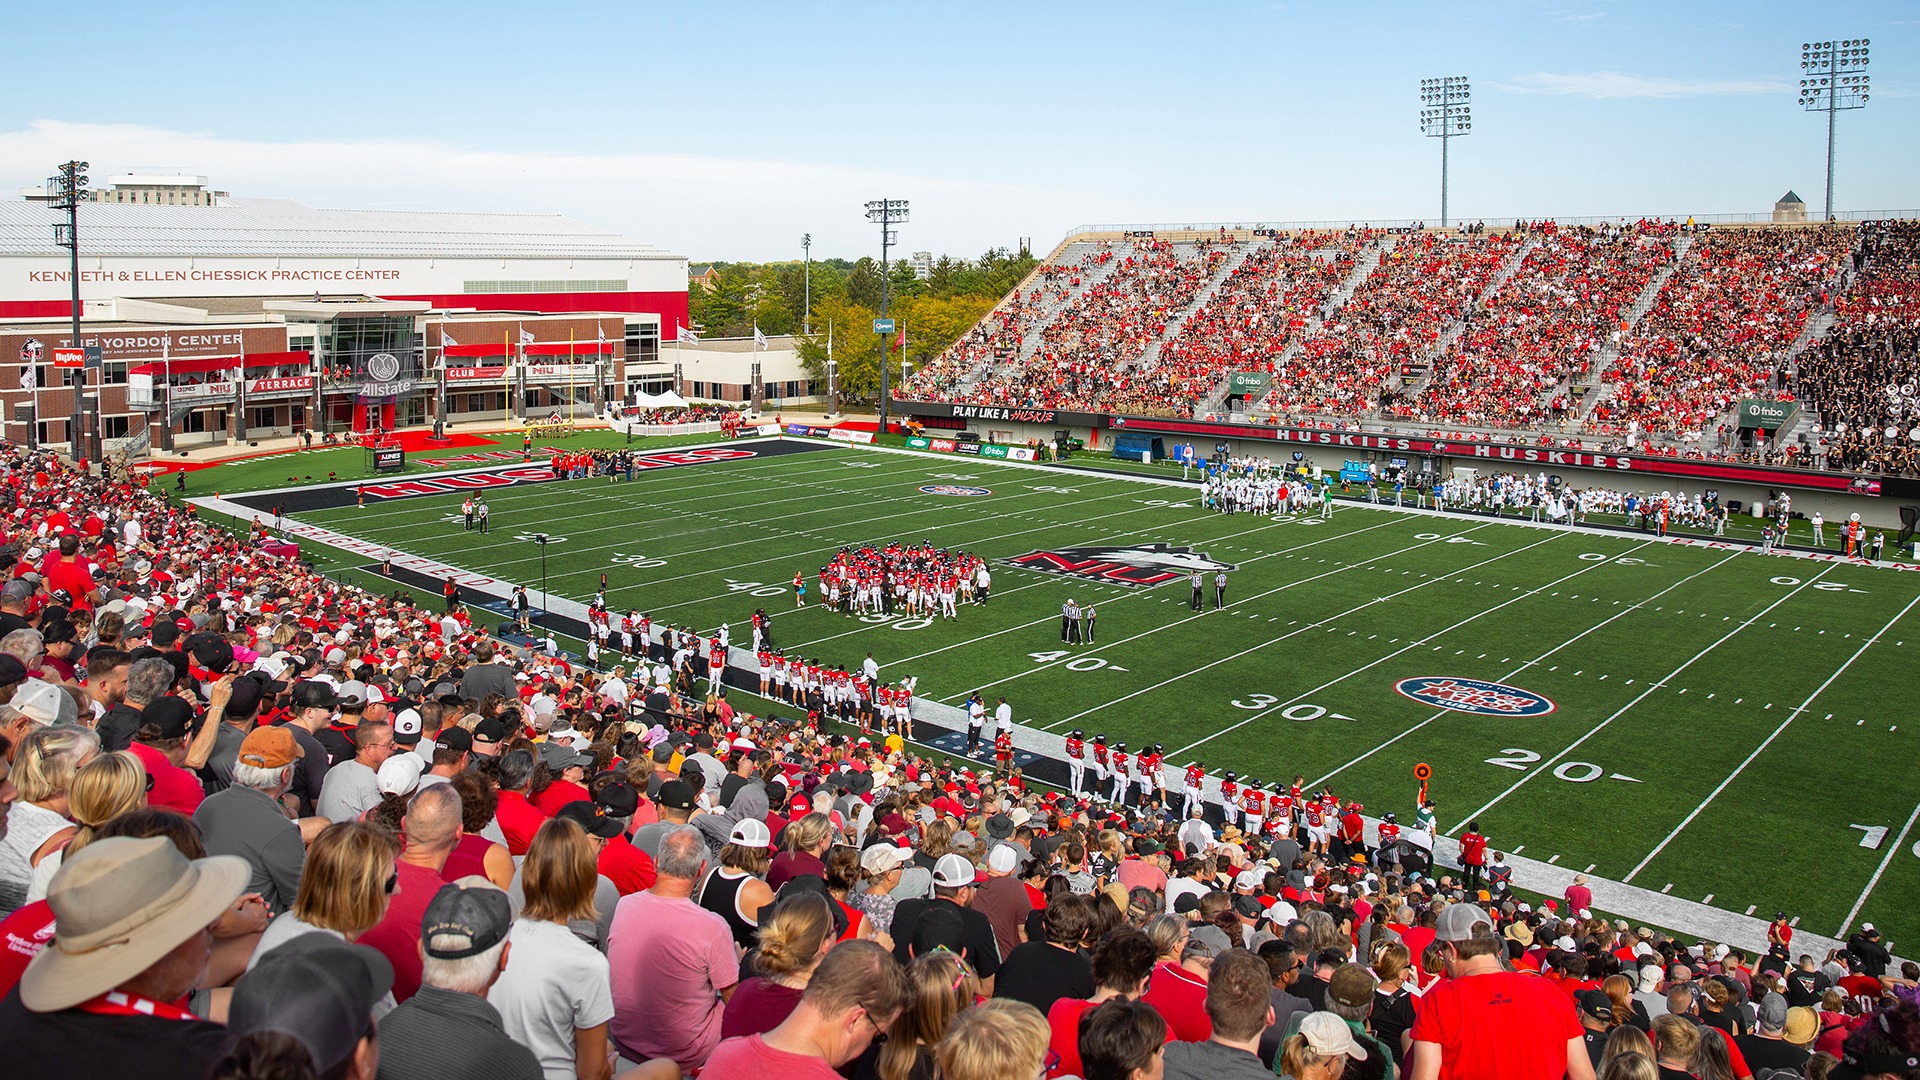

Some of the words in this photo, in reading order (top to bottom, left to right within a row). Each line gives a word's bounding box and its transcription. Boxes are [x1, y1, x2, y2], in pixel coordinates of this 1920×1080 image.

[29, 271, 113, 282] KENNETH
[118, 271, 129, 282] &
[134, 270, 187, 281] ELLEN
[190, 270, 267, 281] CHESSICK
[271, 270, 342, 281] PRACTICE
[345, 269, 400, 280] CENTER
[102, 337, 172, 348] YORDON
[178, 334, 242, 346] CENTER
[449, 369, 475, 378] CLUB
[532, 367, 554, 375] NIU
[209, 384, 231, 394] NIU
[259, 378, 311, 390] TERRACE
[360, 380, 411, 396] Allstate
[952, 405, 977, 418] PLAY
[979, 408, 1000, 420] LIKE
[1001, 409, 1009, 420] A
[1010, 409, 1055, 423] HUSKIE
[1761, 406, 1784, 417] fnbo
[1276, 429, 1410, 450] HUSKIES
[1475, 445, 1631, 470] HUSKIES
[346, 448, 758, 498] HUSIES
[398, 559, 495, 586] FIELD
[1011, 551, 1181, 583] NIU
[1027, 650, 1108, 671] 40
[1422, 679, 1539, 707] Jersey
[1231, 693, 1327, 721] 30
[1435, 699, 1479, 711] SUBS
[1483, 748, 1605, 783] 20
